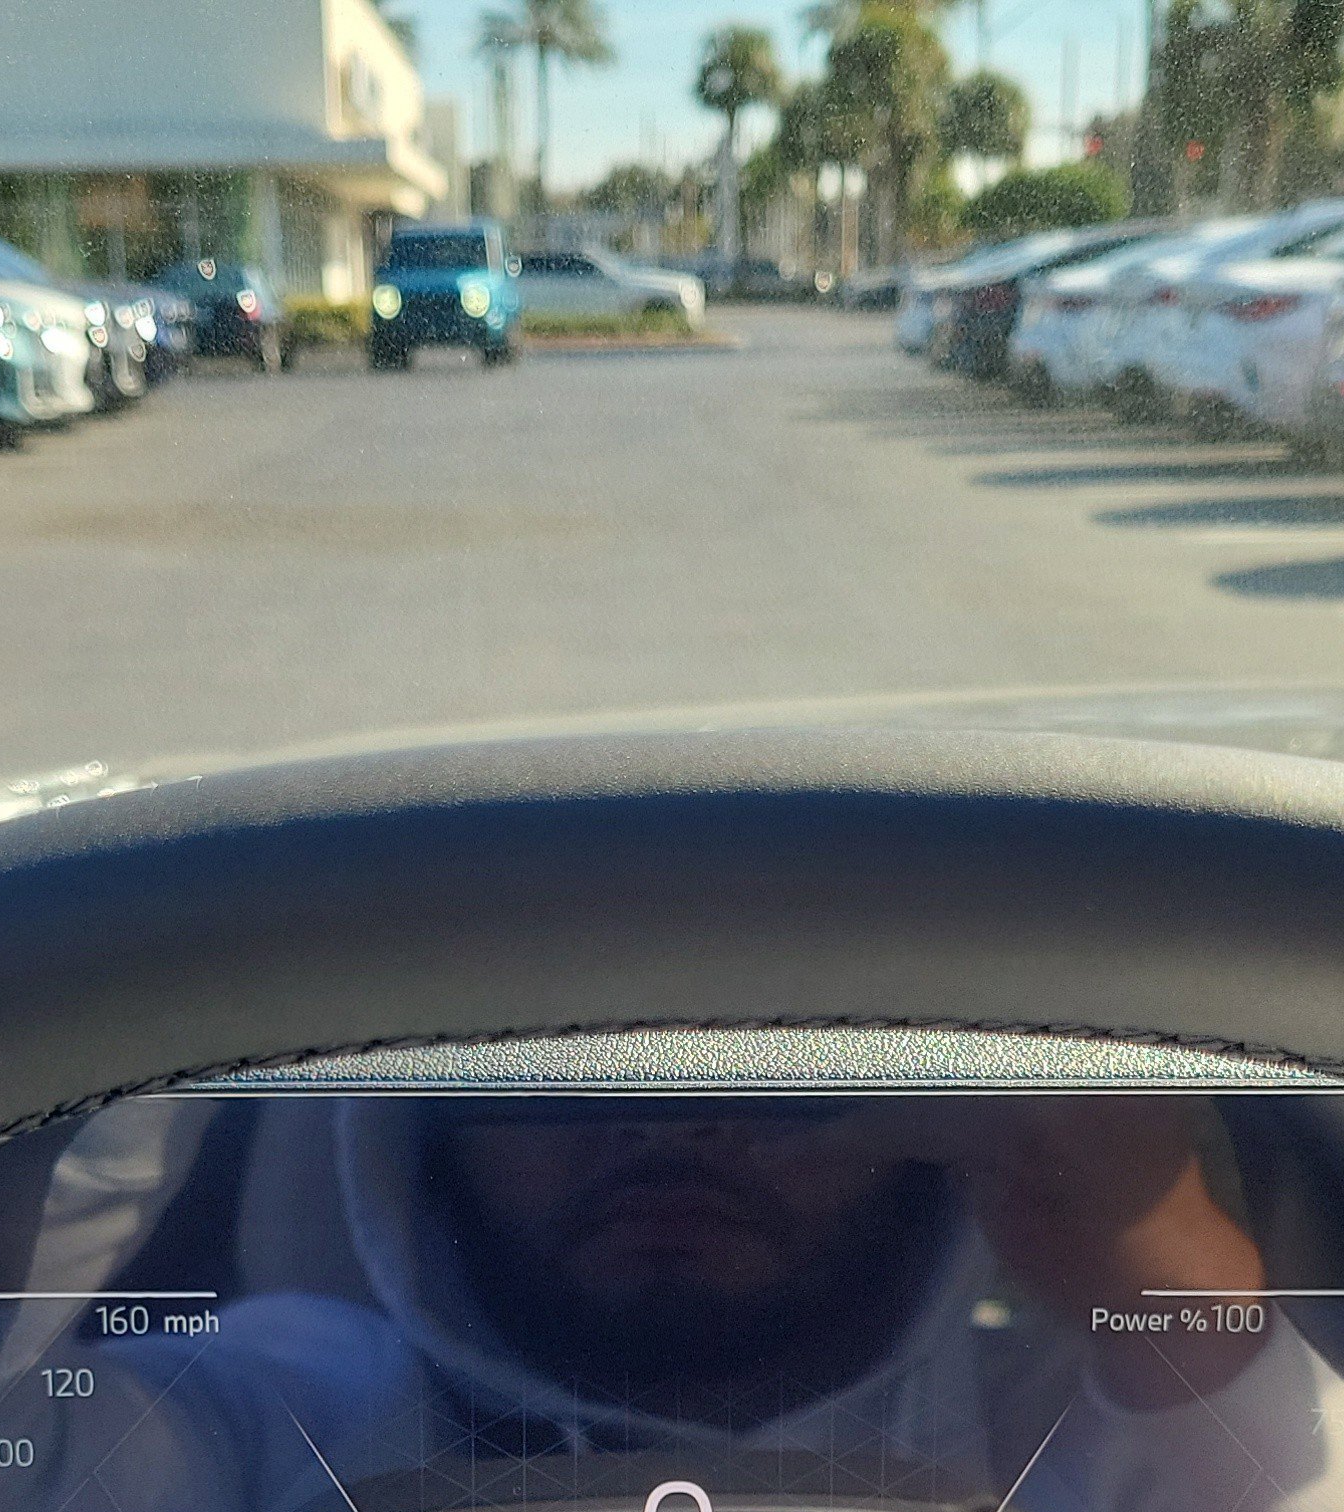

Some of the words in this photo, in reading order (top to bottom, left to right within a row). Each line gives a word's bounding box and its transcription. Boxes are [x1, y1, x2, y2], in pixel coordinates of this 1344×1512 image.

[95, 1305, 149, 1335] 160
[163, 1310, 220, 1337] mph
[1091, 1307, 1173, 1332] Power
[41, 1368, 95, 1398] 120
